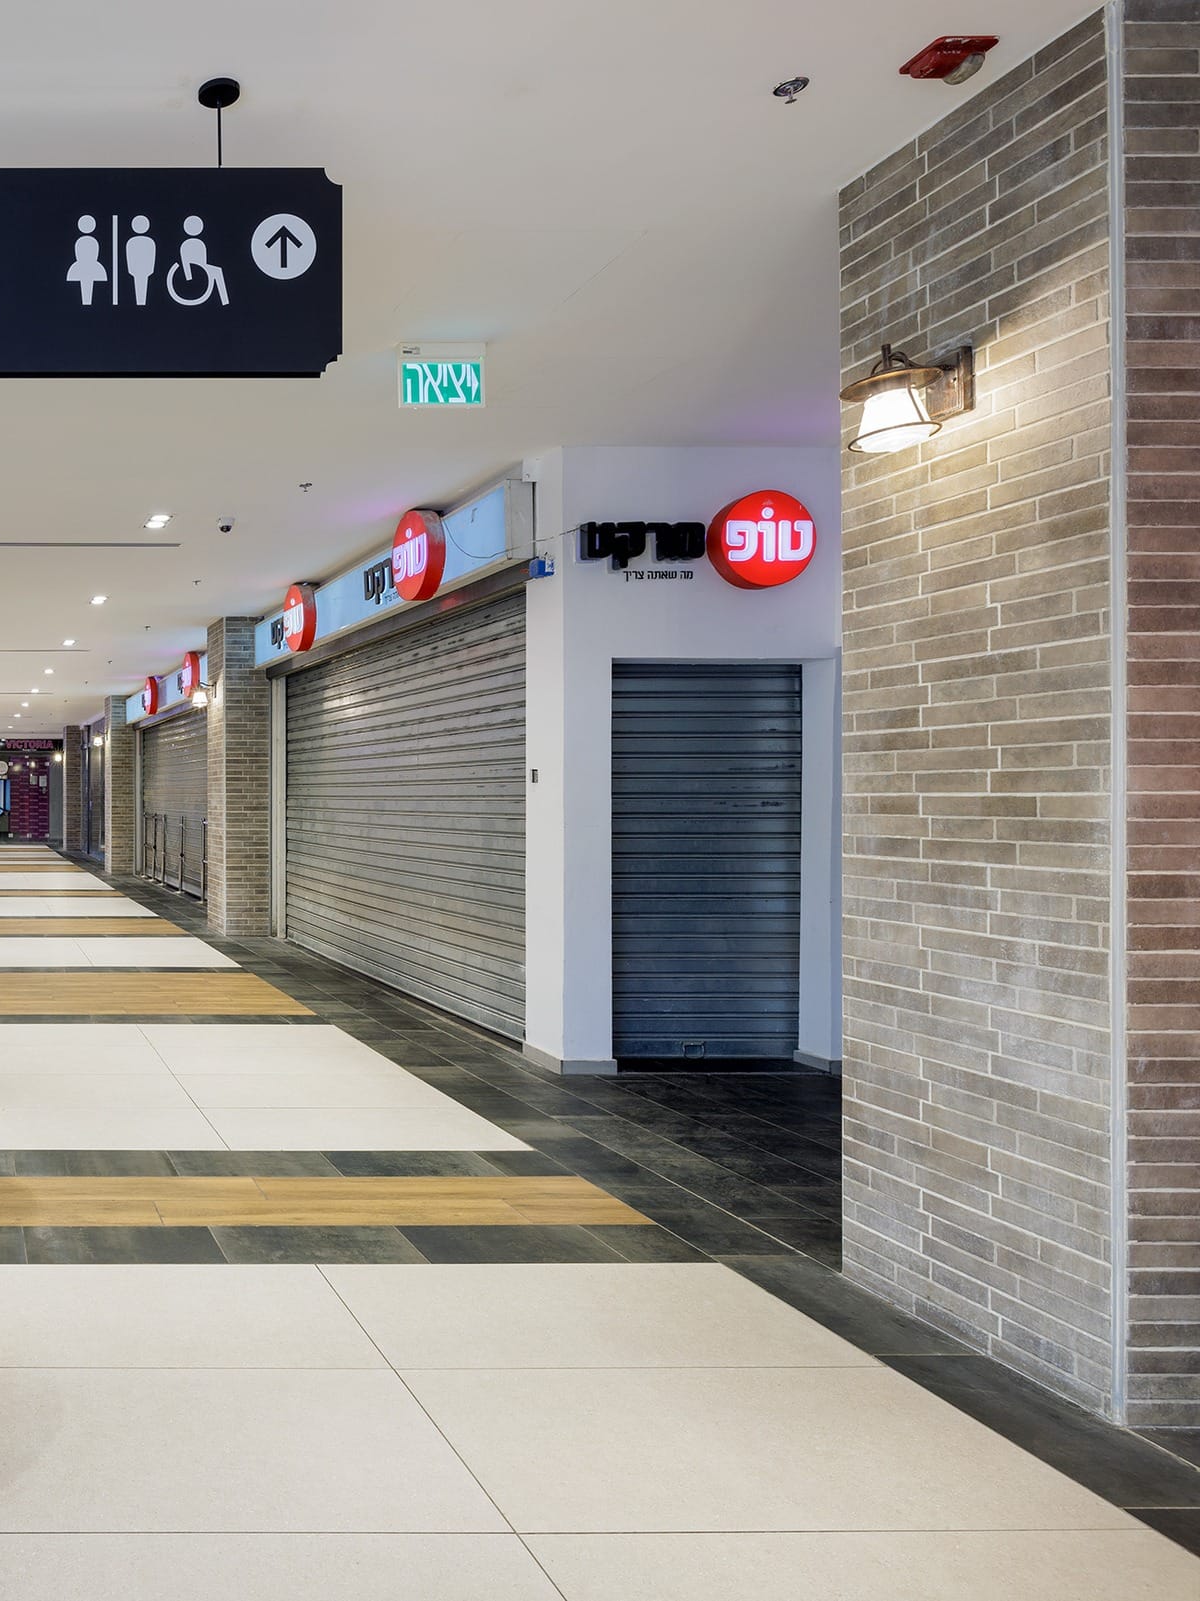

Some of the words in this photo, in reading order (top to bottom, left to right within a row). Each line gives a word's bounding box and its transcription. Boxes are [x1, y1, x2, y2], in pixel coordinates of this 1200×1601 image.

[406, 363, 471, 403] יציאה
[579, 520, 706, 570] מרקט
[726, 506, 814, 562] טופ
[363, 557, 394, 605] רקט
[623, 570, 644, 582] צריך
[647, 570, 677, 580] שאתה
[680, 570, 693, 580] מה
[5, 740, 53, 749] VICTORIA
